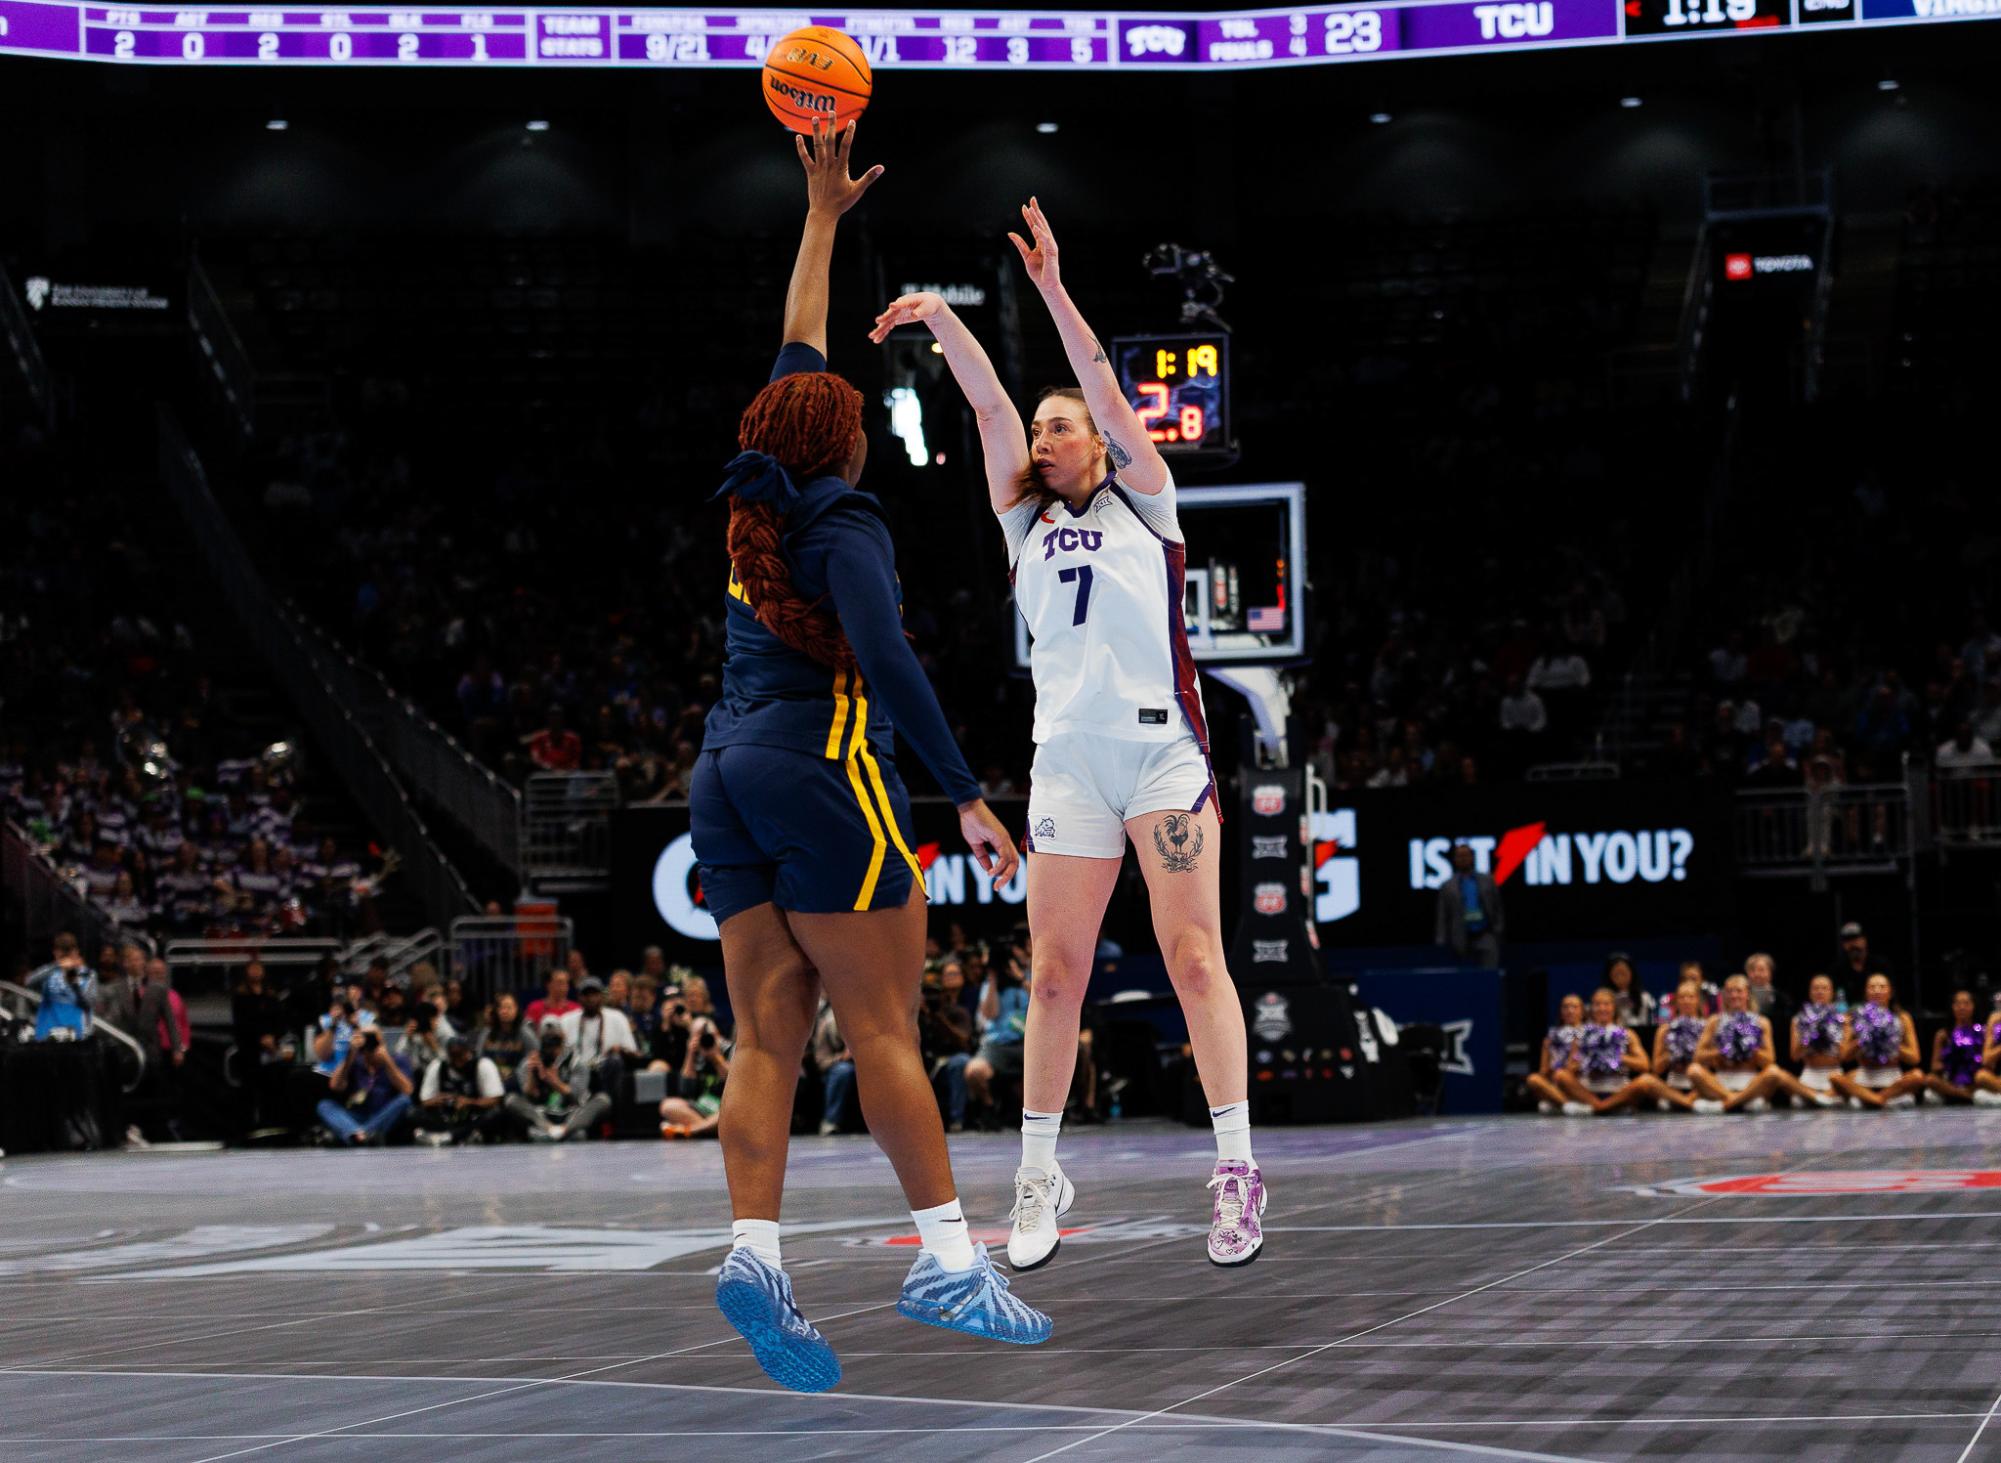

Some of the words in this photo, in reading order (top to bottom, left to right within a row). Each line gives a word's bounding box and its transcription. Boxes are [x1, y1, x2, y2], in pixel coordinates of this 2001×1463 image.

[1324, 11, 1382, 54] 23
[1473, 1, 1554, 39] TCU
[114, 31, 135, 59] 2
[183, 32, 205, 60] 0
[258, 32, 279, 60] 2
[330, 33, 352, 61] 0
[398, 33, 419, 61] 2
[471, 33, 489, 61] 1
[646, 34, 711, 61] 9/21
[942, 36, 977, 62] 12
[1007, 37, 1029, 64] 3
[1071, 37, 1093, 64] 5
[770, 74, 836, 112] Wilson
[1156, 345, 1217, 379] 1:19
[1136, 382, 1203, 442] 2.8
[1042, 526, 1103, 561] TCU
[1057, 564, 1094, 627] 7
[1409, 837, 1453, 889] IS
[1524, 832, 1572, 885] IN
[1574, 828, 1694, 884] YOU?
[967, 853, 1028, 905] YO
